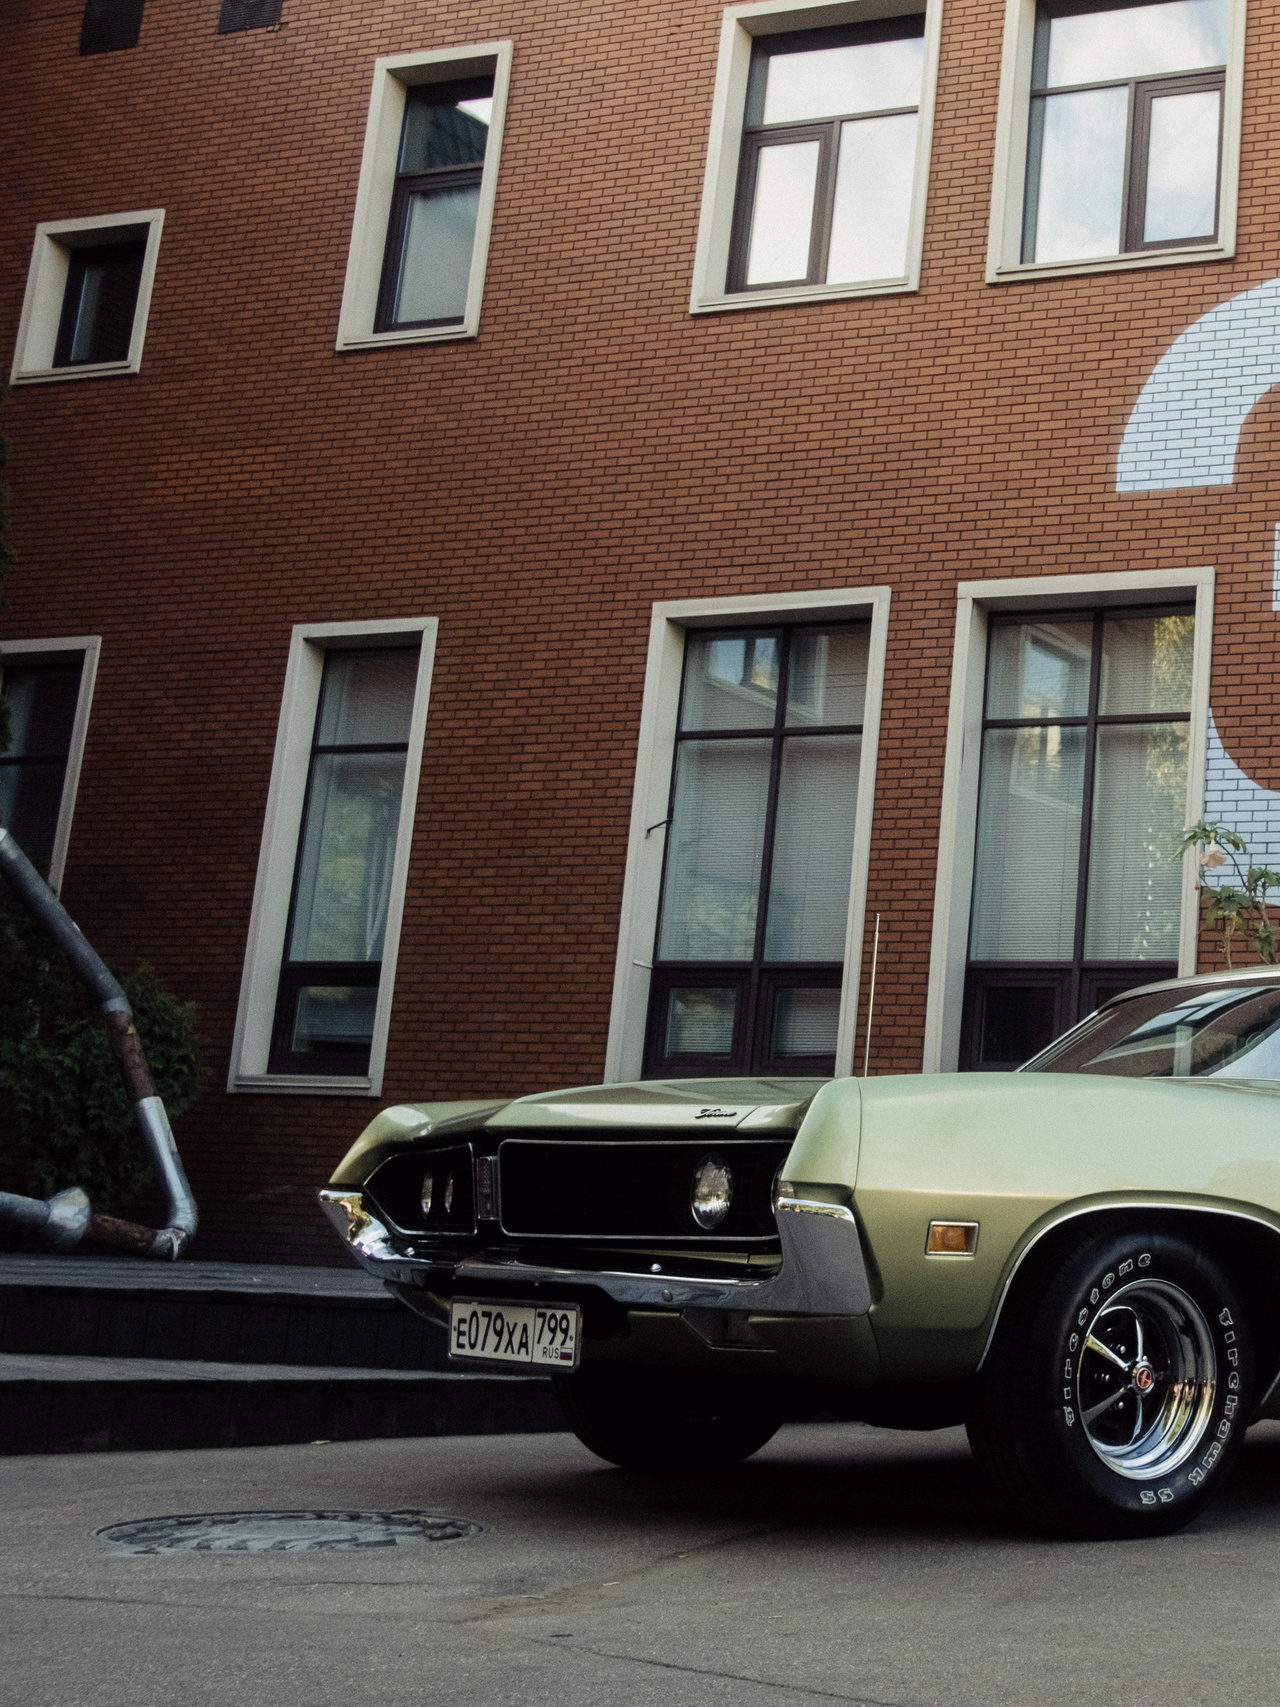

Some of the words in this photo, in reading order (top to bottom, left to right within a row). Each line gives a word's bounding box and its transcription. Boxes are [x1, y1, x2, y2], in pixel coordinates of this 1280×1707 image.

[456, 1310, 529, 1356] E079XA
[537, 1311, 570, 1347] 799
[542, 1346, 560, 1359] RUS
[1064, 1253, 1151, 1426] Firestone
